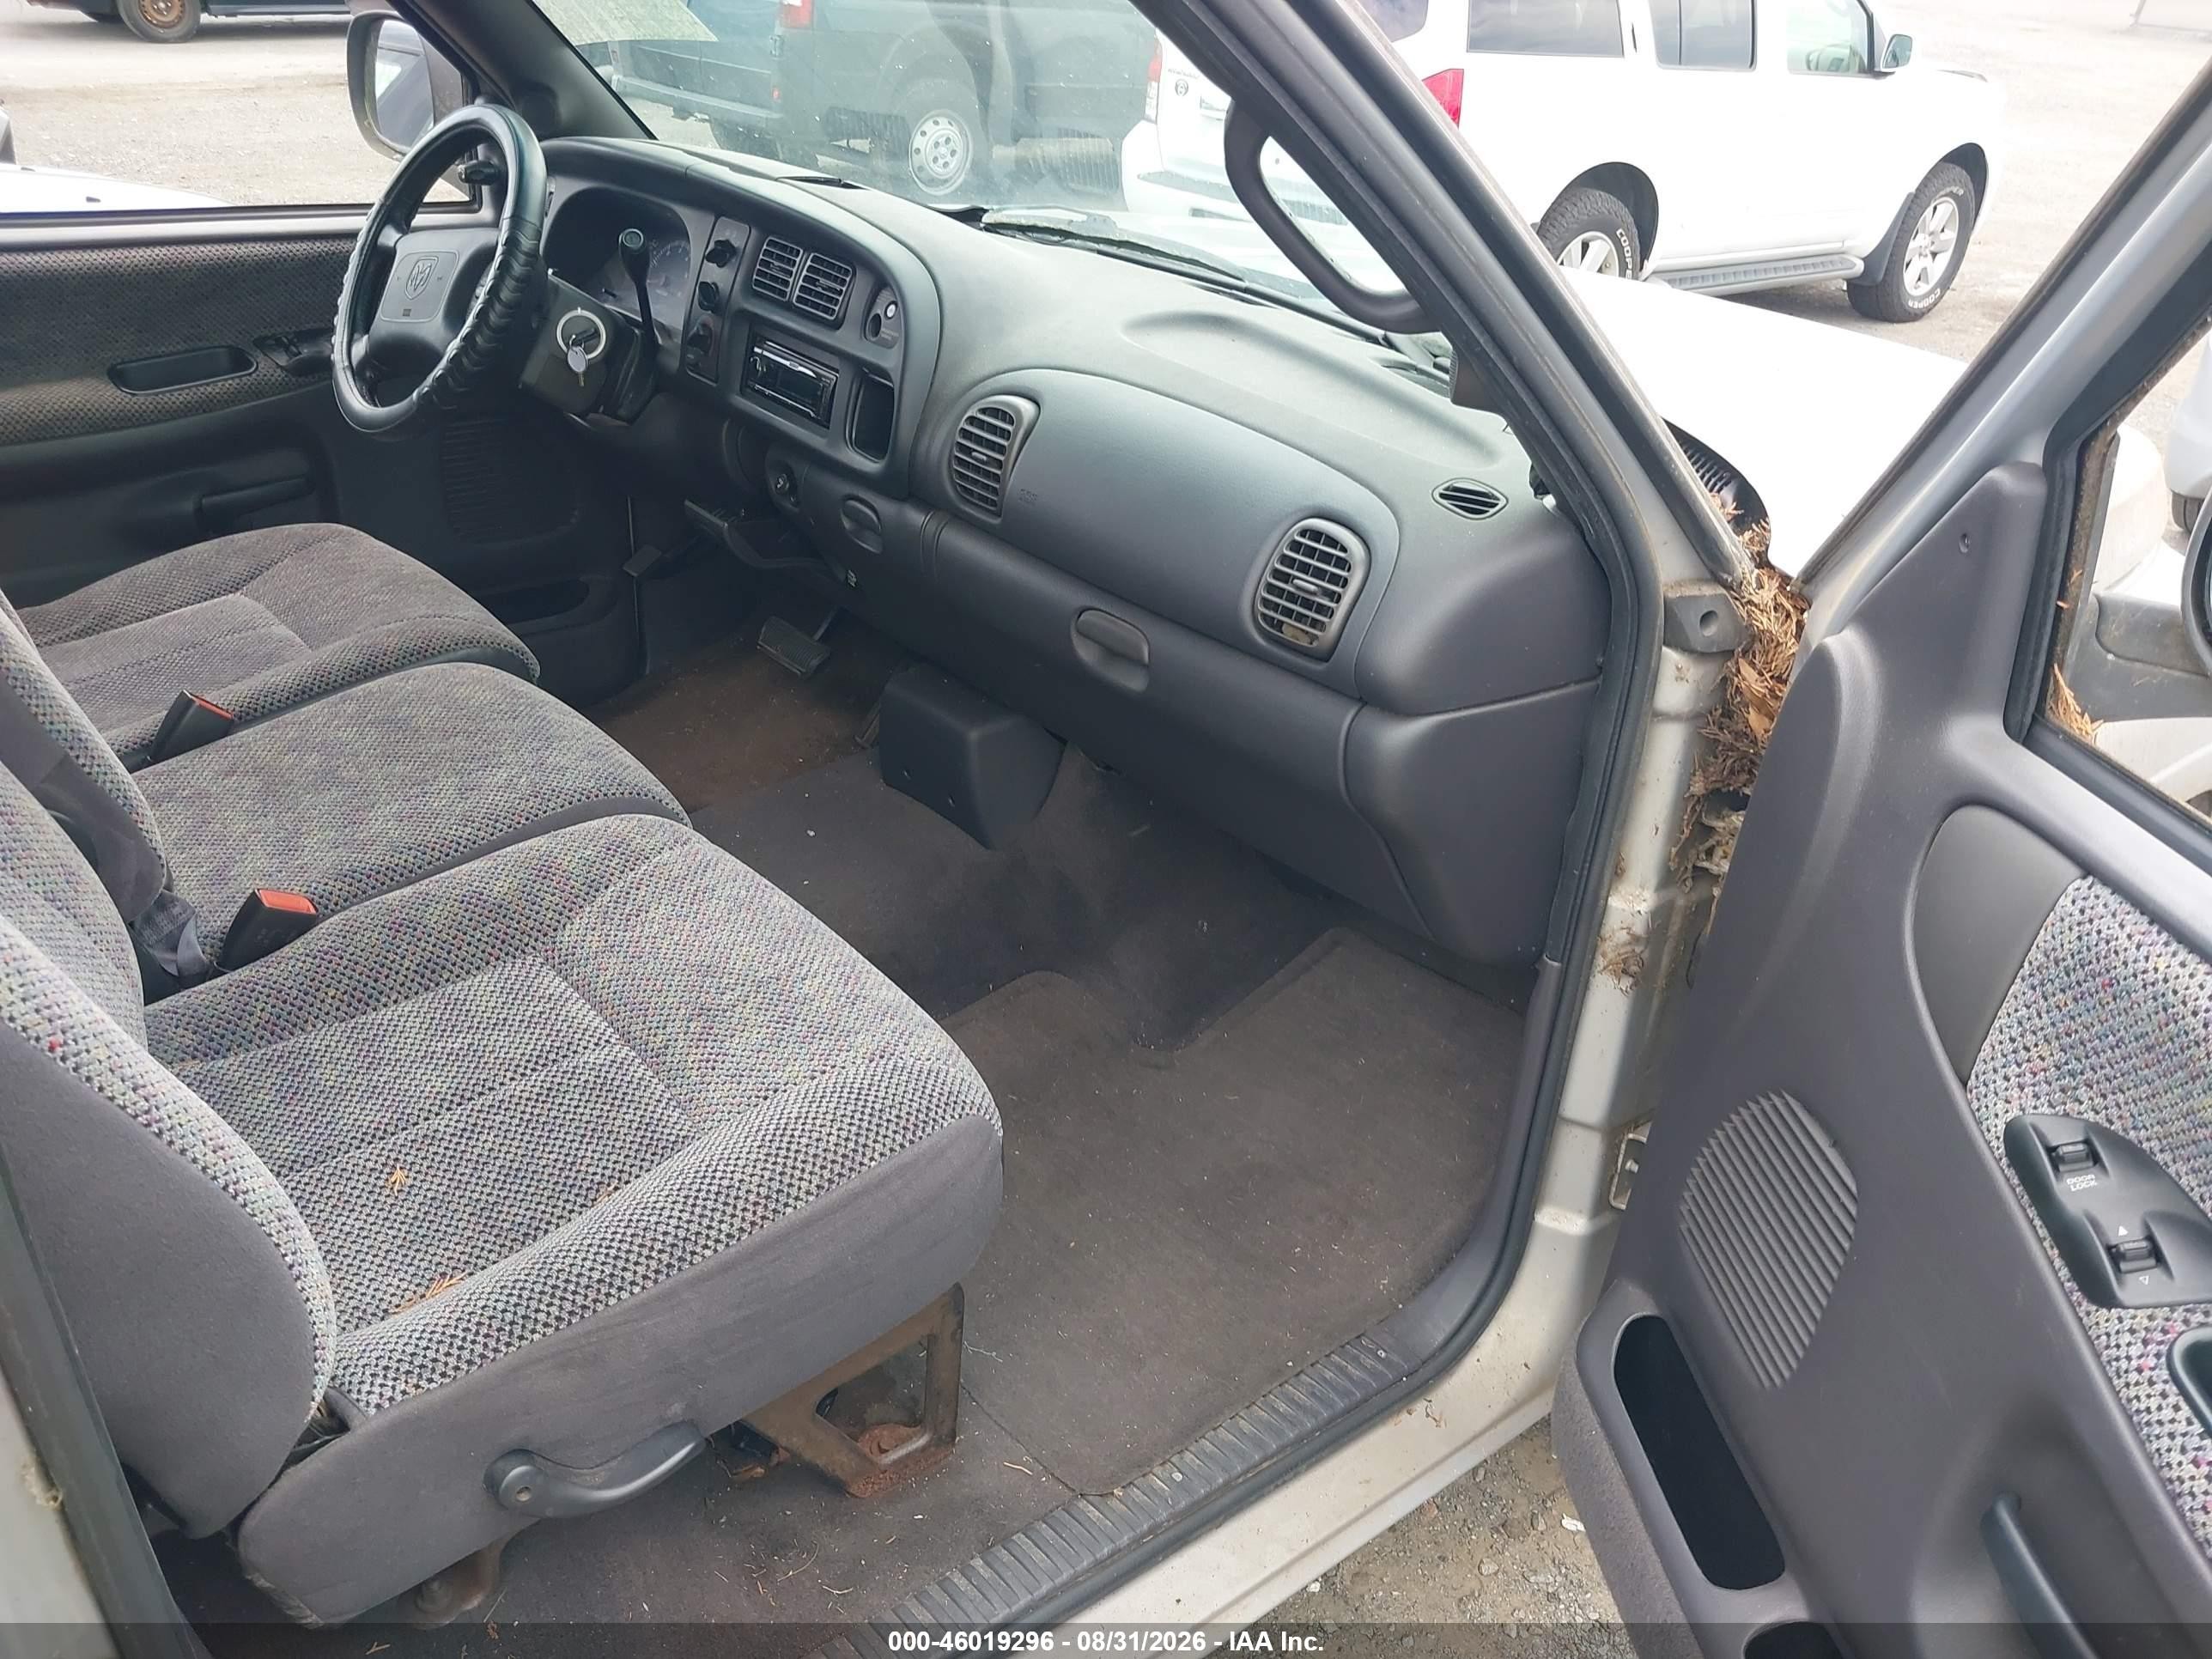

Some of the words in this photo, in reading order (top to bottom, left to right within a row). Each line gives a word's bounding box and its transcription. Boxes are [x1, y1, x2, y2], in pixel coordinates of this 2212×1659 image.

[1616, 228, 1632, 280] COOPE
[1908, 288, 1941, 309] COOPER
[2066, 1174, 2096, 1185] DOOR
[2070, 1180, 2098, 1192] LOCK
